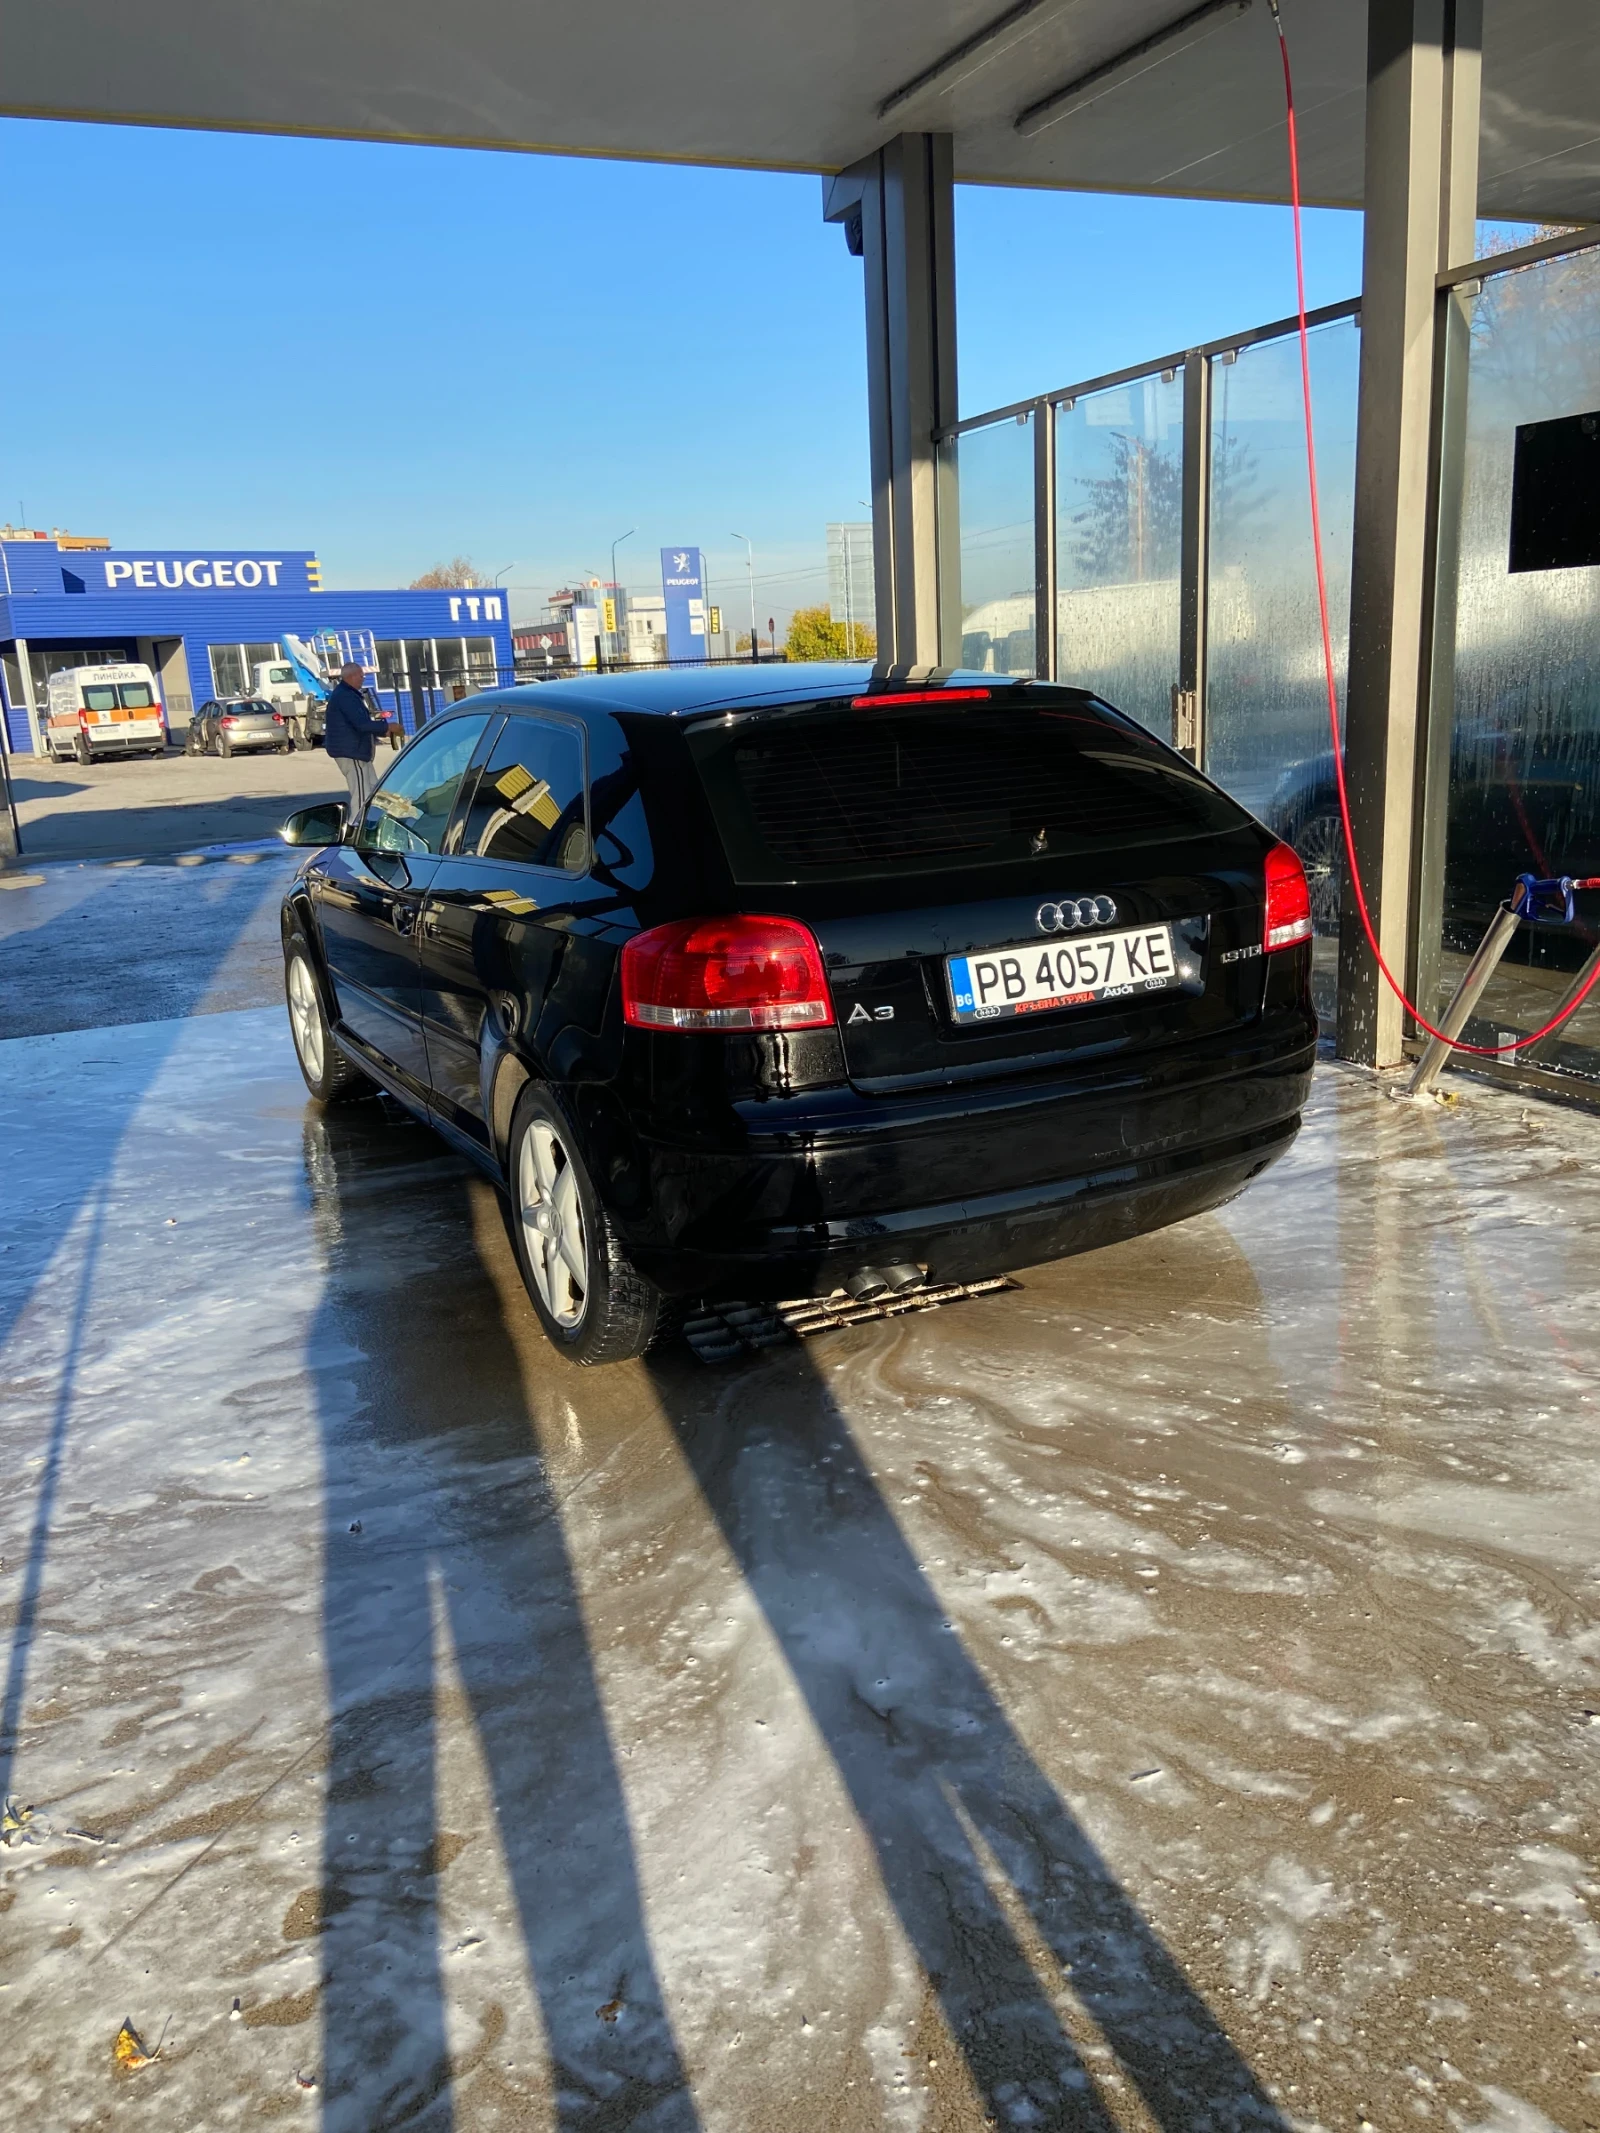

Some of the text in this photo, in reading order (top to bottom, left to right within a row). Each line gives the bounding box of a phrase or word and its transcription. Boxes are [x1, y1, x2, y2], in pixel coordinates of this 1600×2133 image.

[104, 559, 283, 588] PEUGEOT
[666, 578, 699, 586] PEUGEOT
[449, 597, 502, 621] ГТП
[93, 670, 137, 682] ЛИНЕЙКА
[975, 933, 1170, 1004] PB 4057 KE
[956, 993, 973, 1008] BG
[1102, 983, 1134, 999] Audi
[846, 1003, 895, 1025] A3
